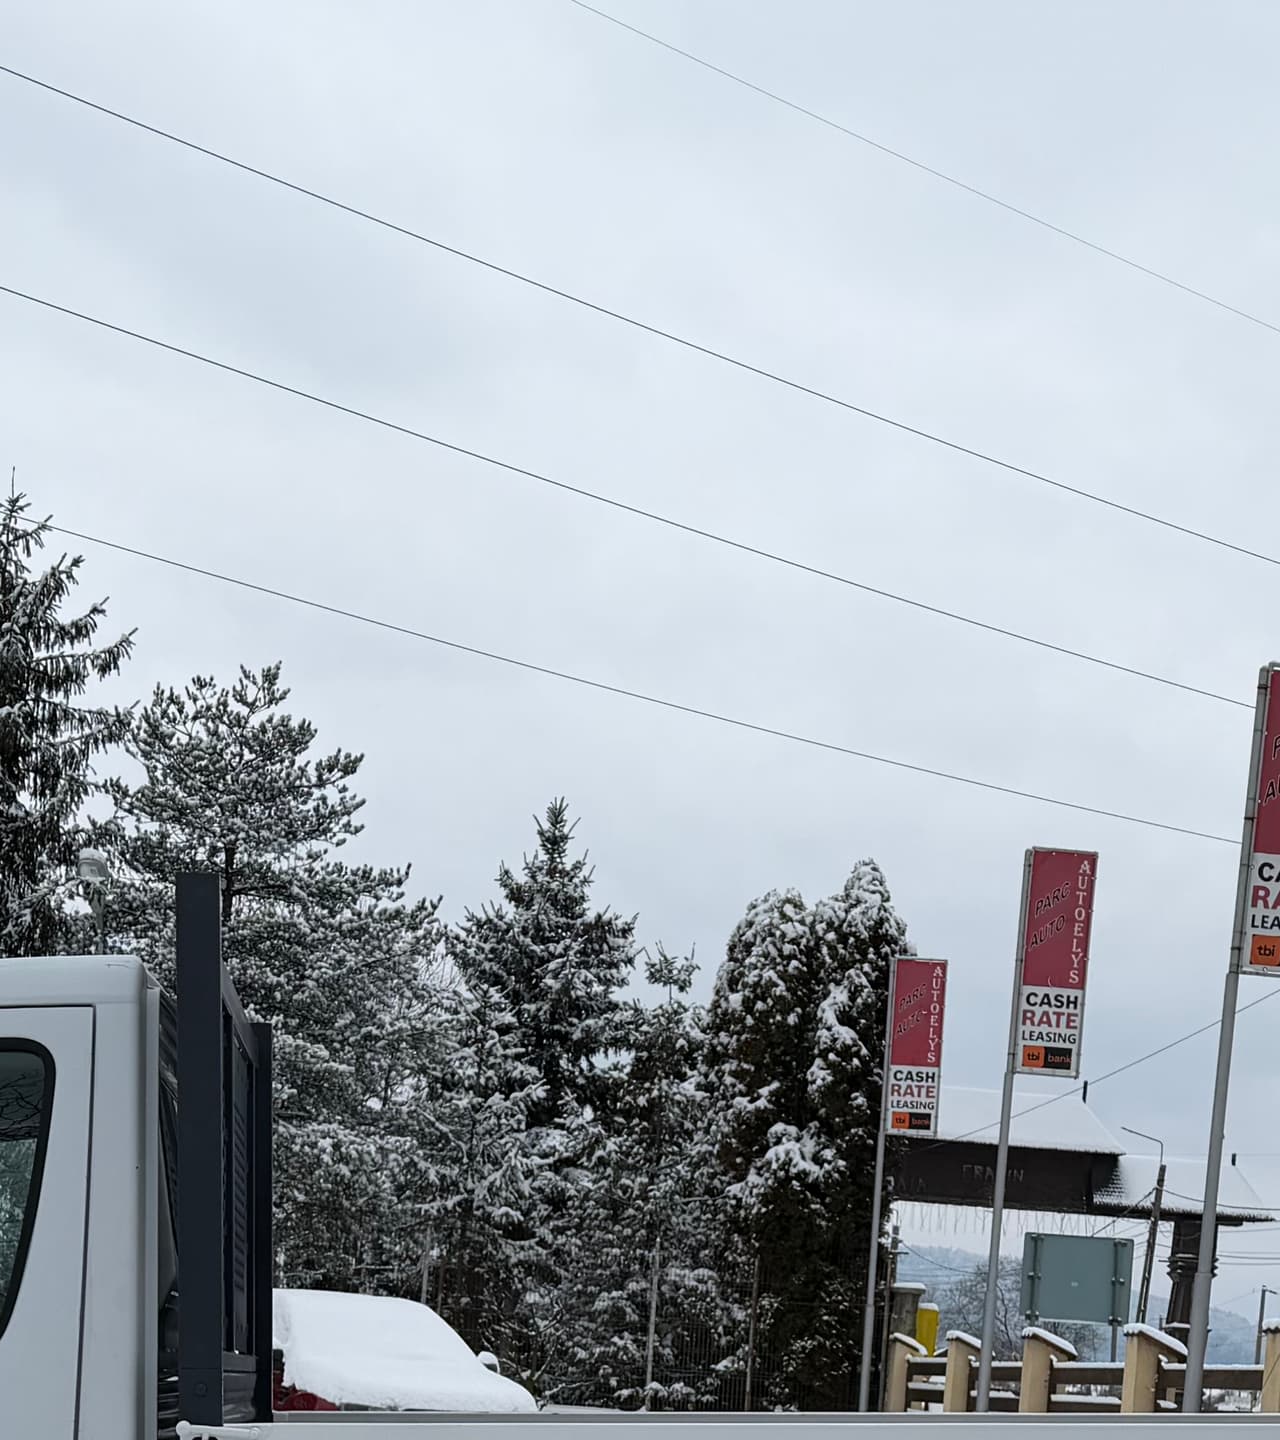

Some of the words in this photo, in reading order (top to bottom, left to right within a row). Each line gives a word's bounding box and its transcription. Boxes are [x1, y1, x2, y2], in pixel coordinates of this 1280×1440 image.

[1034, 882, 1071, 918] PARC
[1069, 860, 1091, 984] AUTOELYS
[1028, 914, 1066, 951] AUTO
[1257, 944, 1276, 957] tbi
[1026, 992, 1079, 1010] CASH
[927, 966, 944, 1063] AUTOELYS
[1022, 1010, 1079, 1030] RATE
[1022, 1030, 1077, 1044] LEASING
[1027, 1052, 1040, 1061] tbi
[1048, 1052, 1072, 1063] bank
[893, 1070, 936, 1083] CASH
[891, 1084, 936, 1098] RATE
[891, 1100, 935, 1110] LEASING
